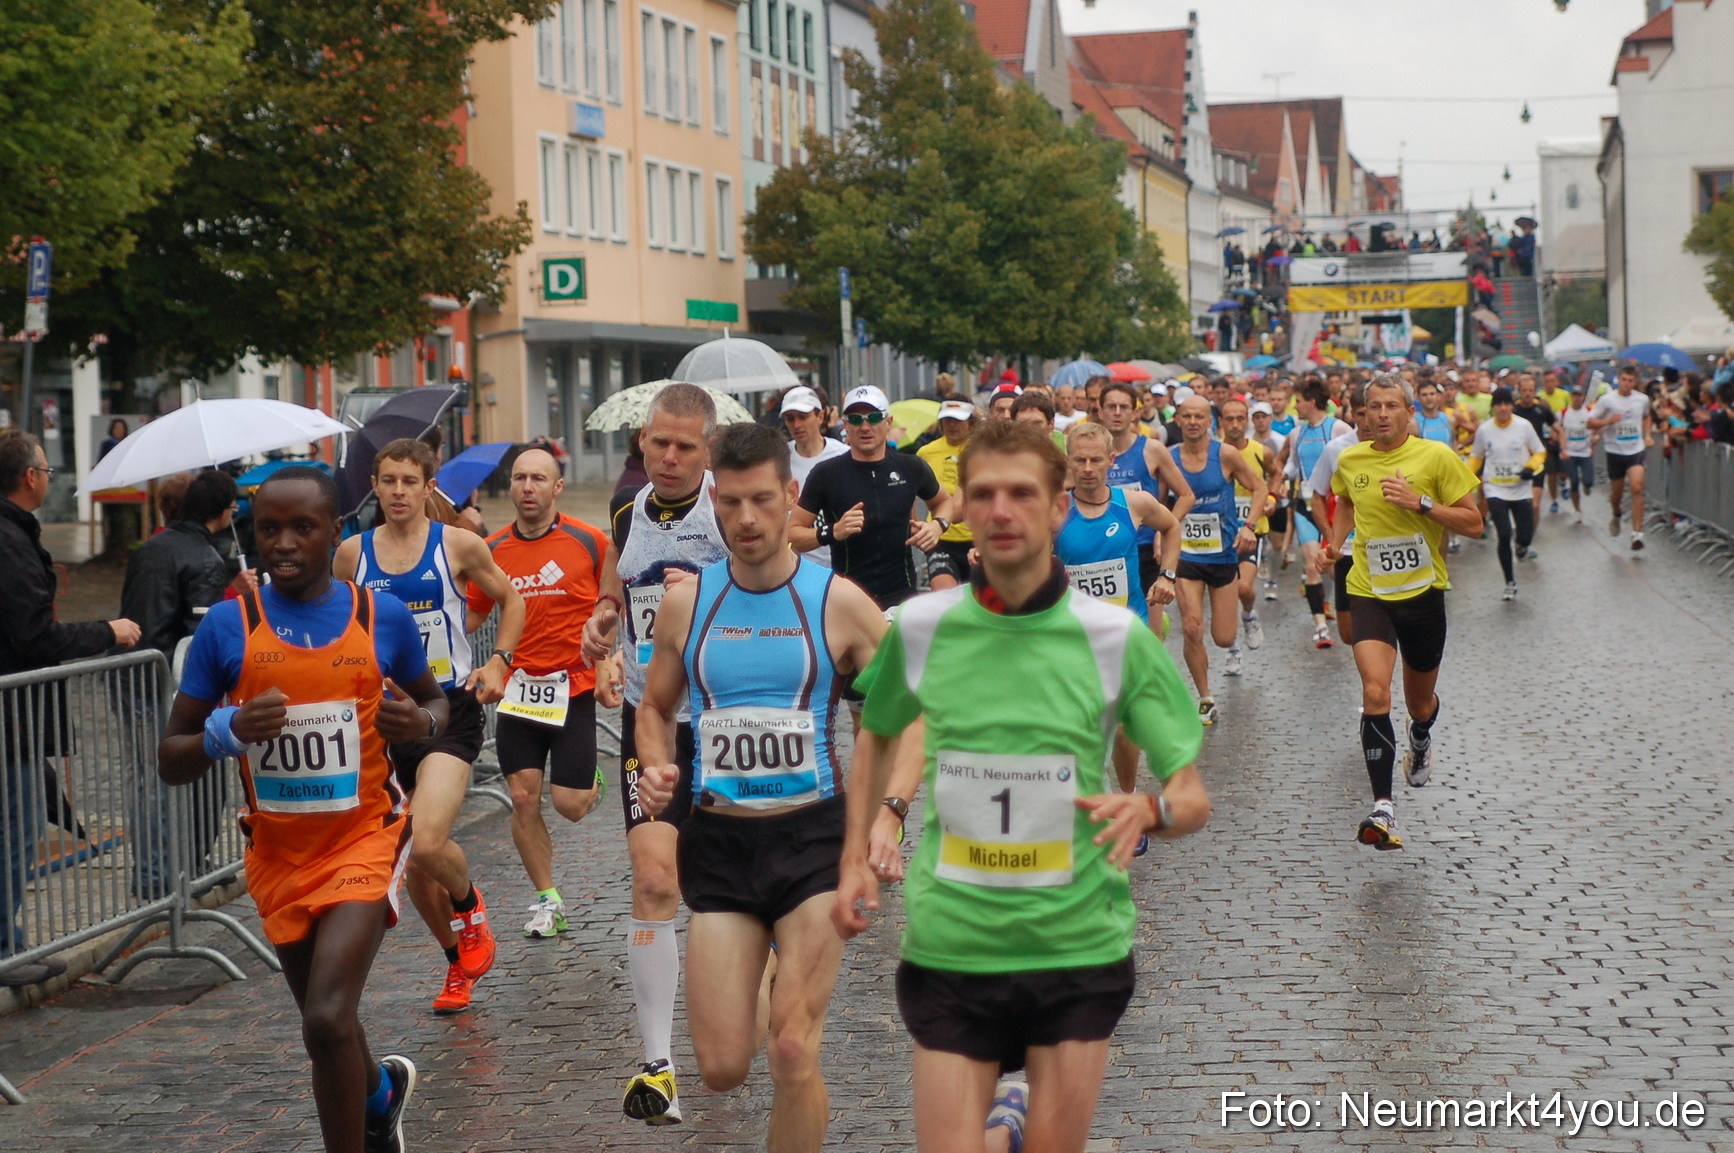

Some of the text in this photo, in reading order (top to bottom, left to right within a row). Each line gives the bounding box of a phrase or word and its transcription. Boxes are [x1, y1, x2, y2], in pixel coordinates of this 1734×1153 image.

[548, 263, 579, 295] D
[1346, 288, 1408, 305] START
[676, 533, 708, 542] DIADORA
[1184, 523, 1211, 538] 356
[1379, 548, 1420, 572] 539
[365, 579, 391, 588] HEITEC
[1077, 575, 1117, 598] 555
[632, 595, 660, 604] PARTL
[344, 656, 368, 666] asics
[519, 682, 556, 704] 199
[511, 705, 554, 718] Alexander
[701, 717, 793, 729] PARTL Neumarkt
[257, 727, 347, 773] 2001
[711, 732, 805, 772] 2000
[940, 763, 1051, 781] PARTL Neumarkt
[279, 782, 335, 799] Zachary
[737, 782, 783, 796] Marco
[990, 787, 1011, 835] 1
[969, 846, 1037, 868] Michael
[346, 876, 370, 885] asics
